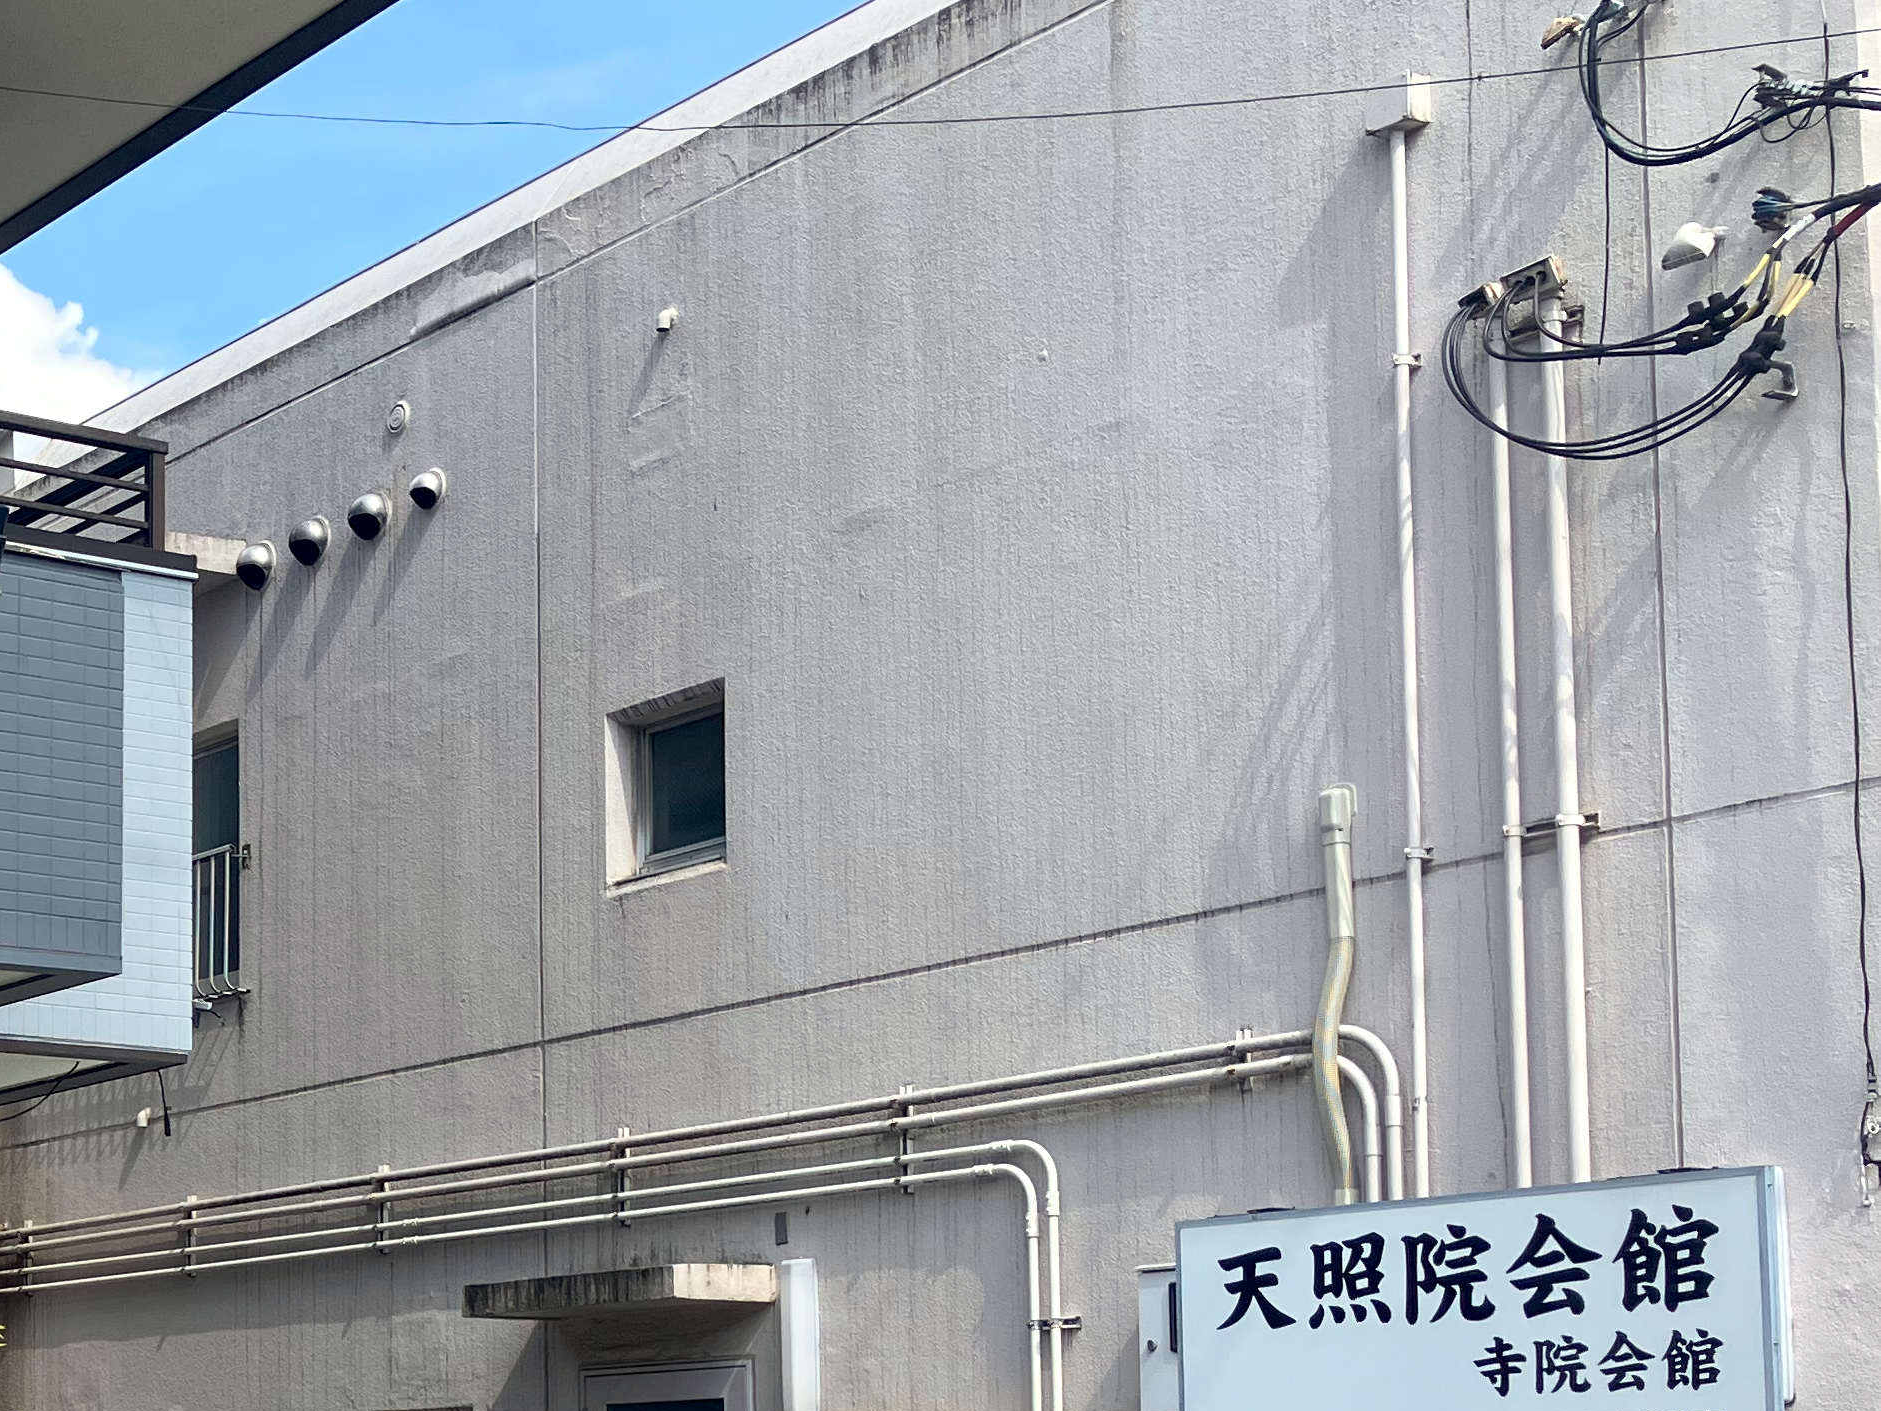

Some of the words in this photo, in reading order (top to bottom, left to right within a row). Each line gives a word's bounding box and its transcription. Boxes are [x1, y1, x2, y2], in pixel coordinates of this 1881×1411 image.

[1216, 1204, 1721, 1331] 天照院会館
[1472, 1327, 1725, 1397] 寺院会館
